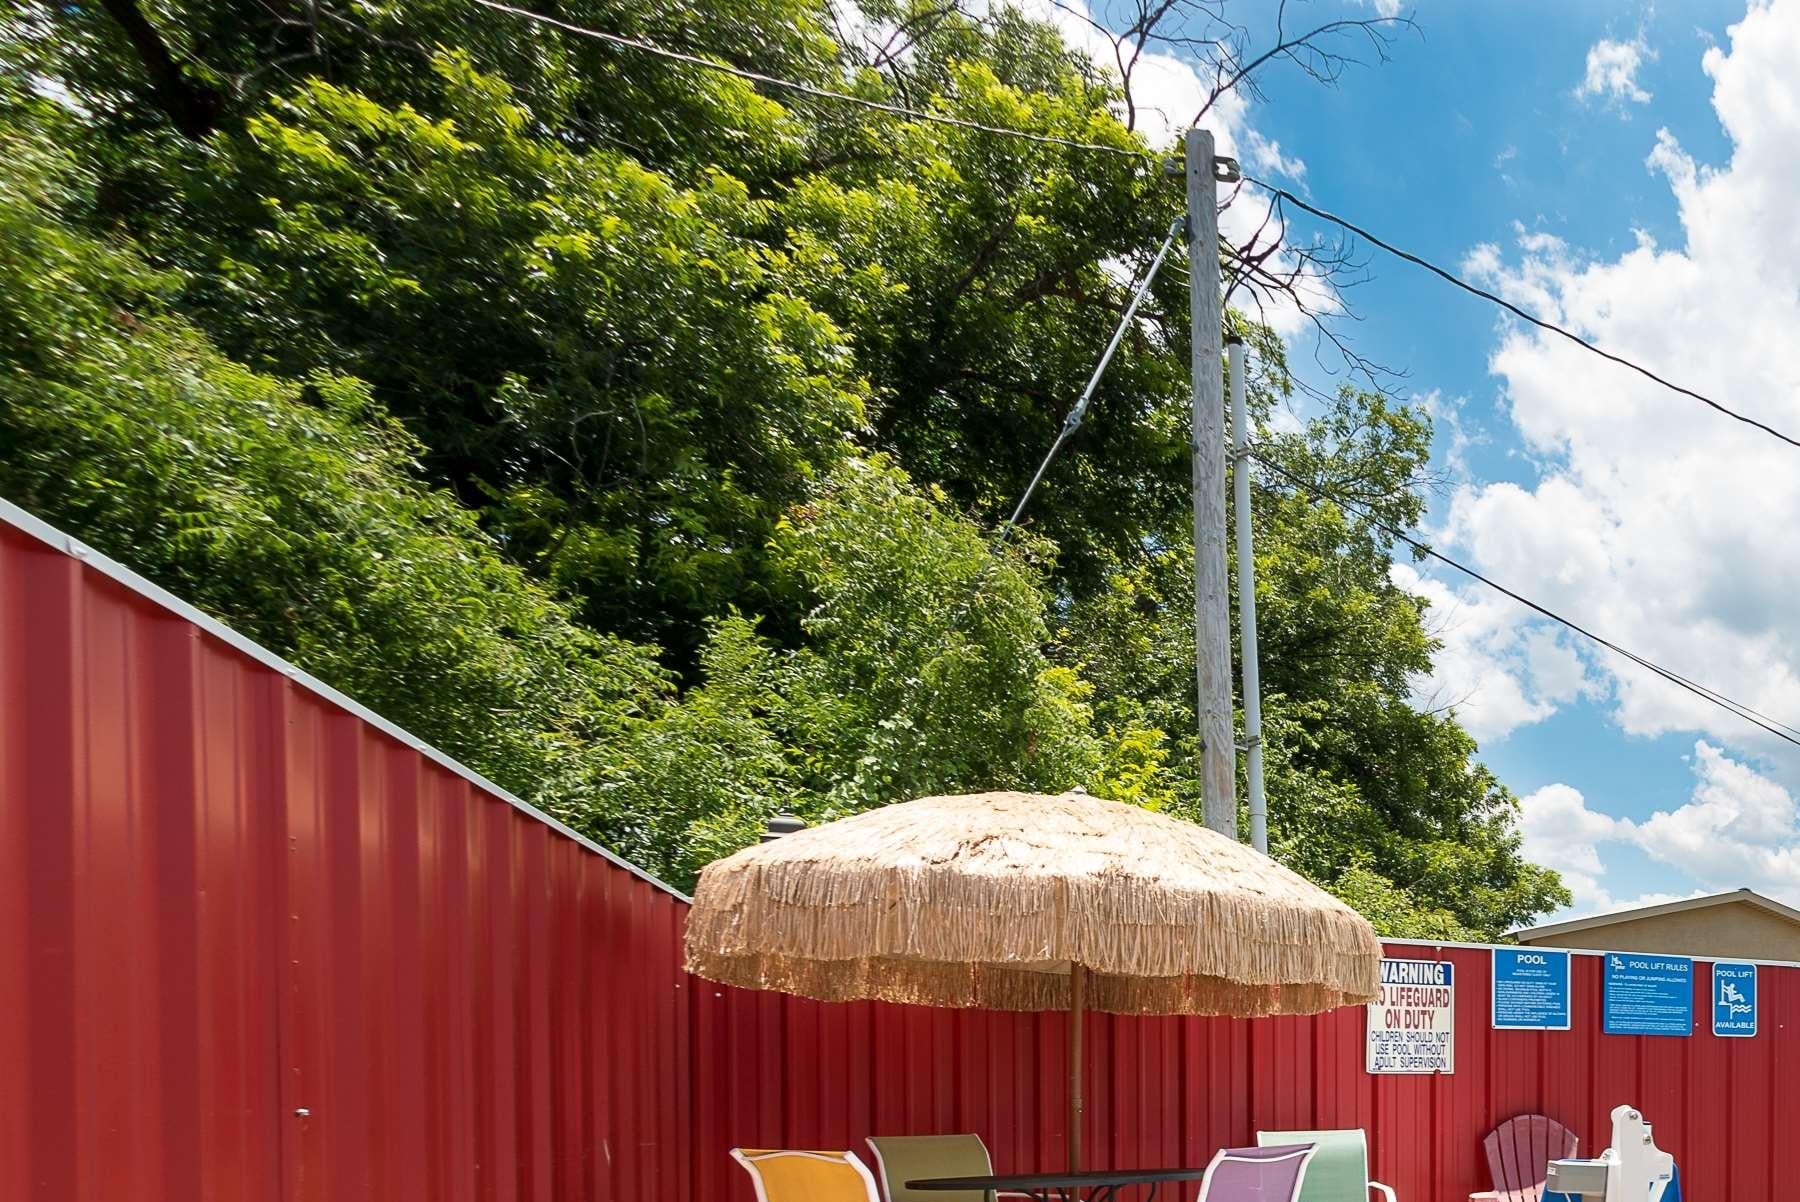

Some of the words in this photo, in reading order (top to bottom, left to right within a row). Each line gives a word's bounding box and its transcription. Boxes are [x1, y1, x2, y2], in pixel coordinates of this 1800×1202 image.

[1517, 954, 1547, 965] POOL
[1629, 960, 1649, 970] POOL
[1650, 962, 1665, 970] LIFT
[1665, 963, 1688, 972] RULES
[1371, 986, 1386, 1006] O
[1390, 986, 1450, 1008] LIFEGUARD
[1385, 1008, 1400, 1029] ON
[1404, 1009, 1435, 1030] DUTY
[1715, 1021, 1755, 1029] AVAILABLE
[1371, 1030, 1403, 1043] CHILDREN
[1406, 1031, 1433, 1043] SHOULD
[1435, 1032, 1450, 1043] NOT
[1375, 1043, 1389, 1055] USE
[1392, 1044, 1412, 1056] POOL
[1414, 1044, 1446, 1056] WITHOUT
[1374, 1056, 1397, 1068] ADULT
[1400, 1056, 1447, 1069] SUPERVISION
